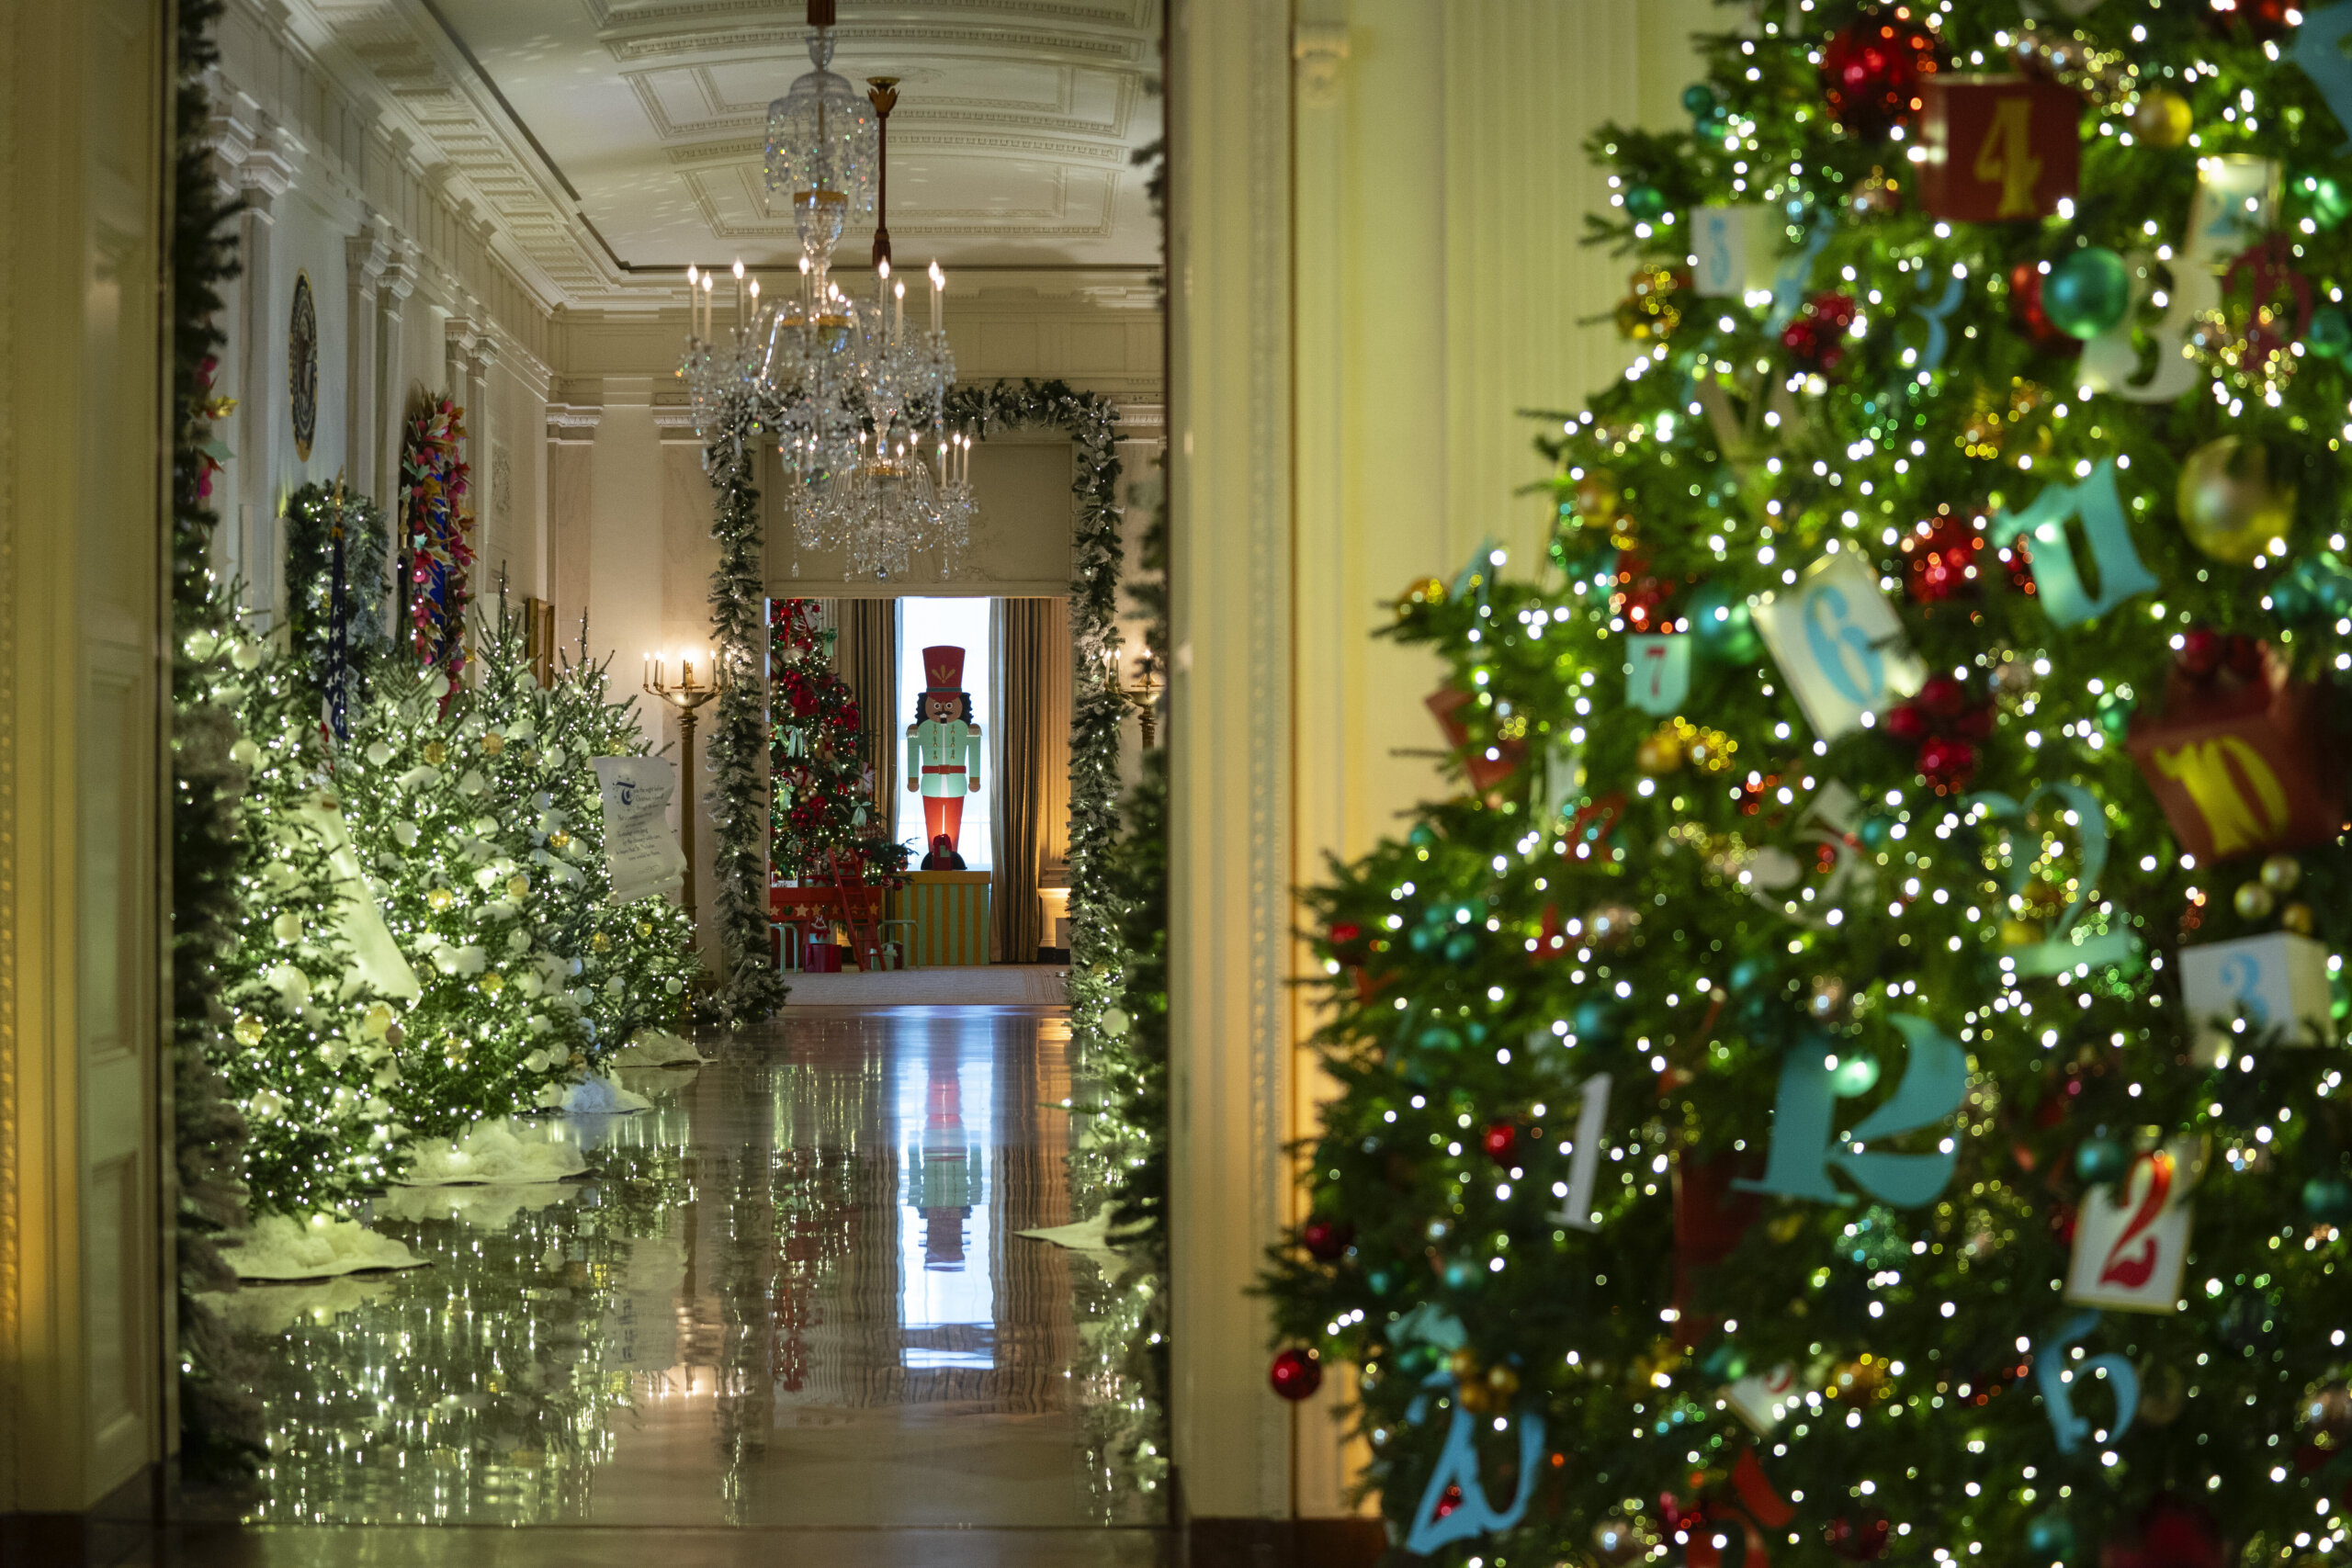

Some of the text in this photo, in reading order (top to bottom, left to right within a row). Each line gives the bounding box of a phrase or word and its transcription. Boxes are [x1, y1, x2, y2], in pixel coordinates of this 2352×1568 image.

[1975, 97, 2043, 217] 4
[1645, 647, 1668, 696] 7
[1803, 584, 1885, 705] 6
[2154, 735, 2290, 856] 10
[1546, 1071, 1615, 1233] 1
[1730, 1012, 1968, 1209] 12
[2098, 1151, 2174, 1290] 2
